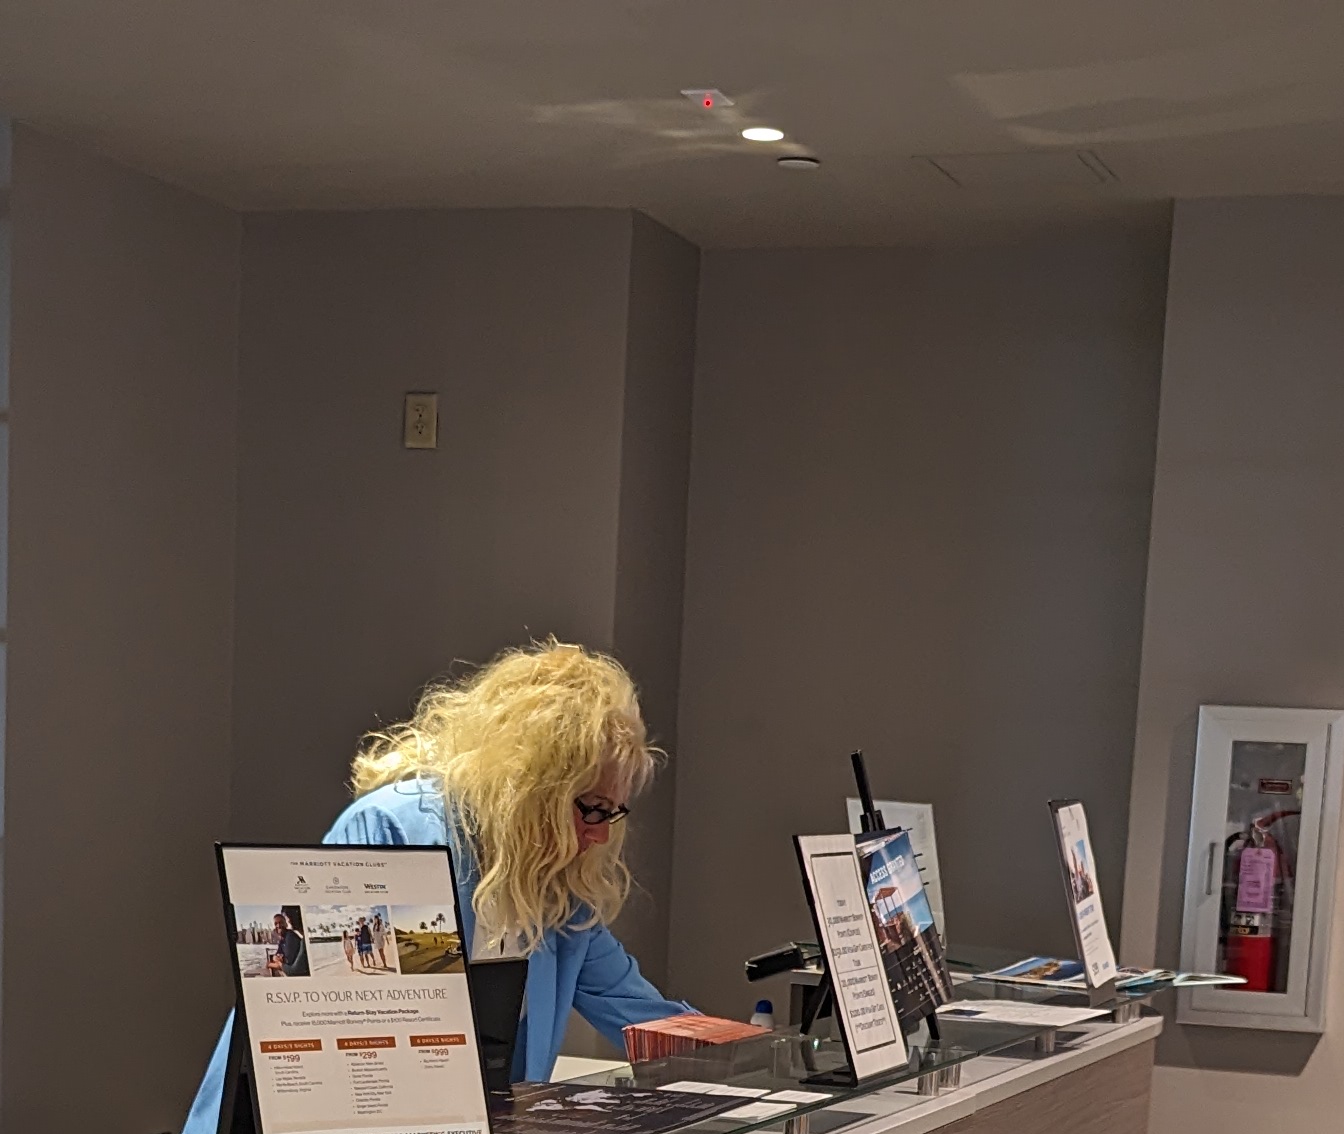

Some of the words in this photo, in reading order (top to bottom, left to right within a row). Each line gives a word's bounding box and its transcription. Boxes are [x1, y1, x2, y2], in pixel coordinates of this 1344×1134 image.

[266, 992, 302, 1004] R.S.V.P.
[305, 992, 320, 1003] TO
[322, 990, 353, 1003] YOUR
[356, 989, 384, 1001] NEXT
[386, 988, 448, 1001] ADVENTURE
[359, 1051, 377, 1059] $299
